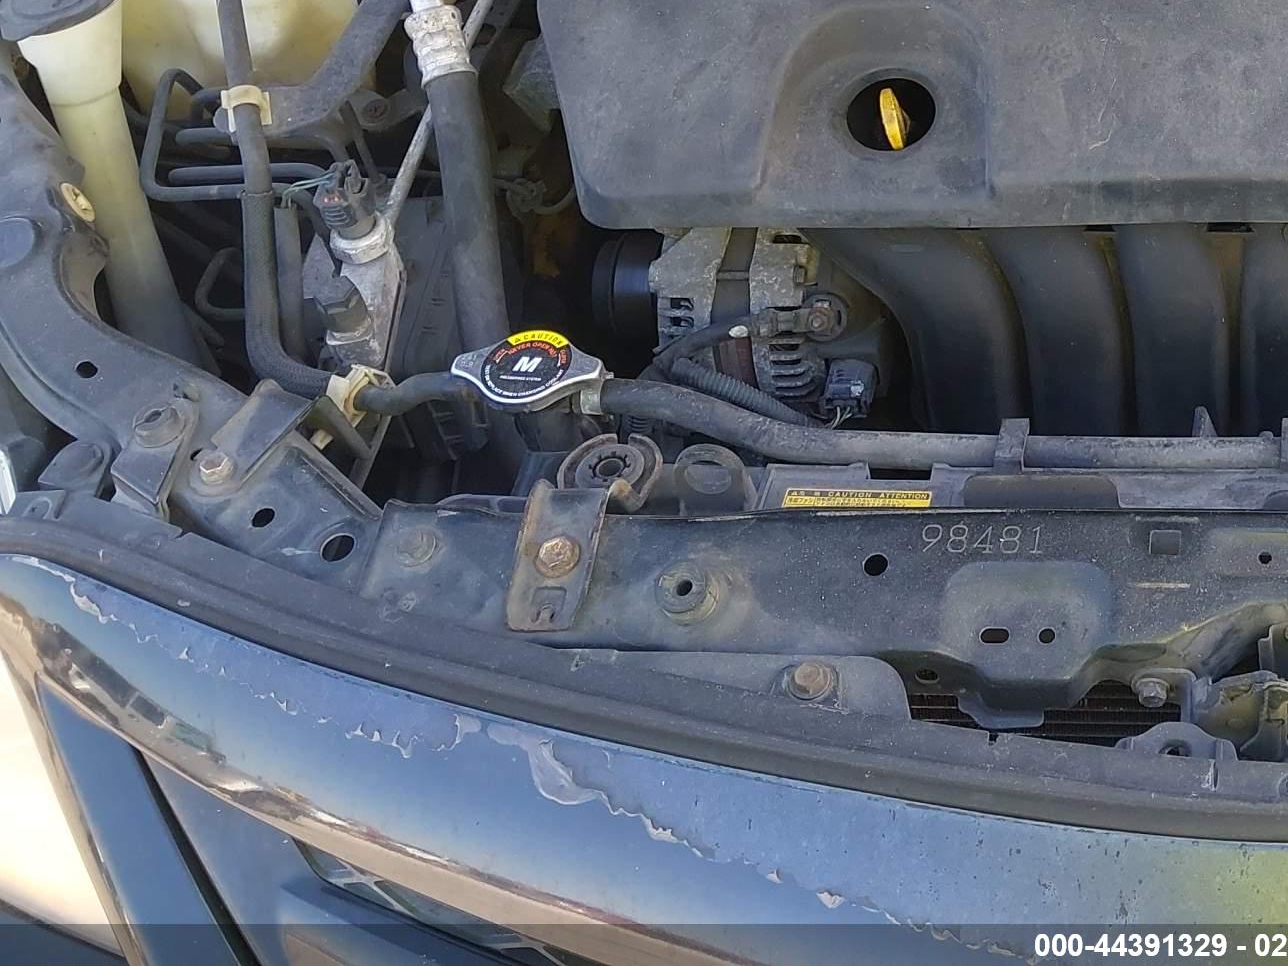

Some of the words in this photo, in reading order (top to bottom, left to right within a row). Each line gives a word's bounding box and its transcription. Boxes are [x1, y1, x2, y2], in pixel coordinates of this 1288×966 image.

[523, 332, 563, 345] CAUTION
[512, 356, 543, 373] M
[922, 524, 1042, 554] 98481
